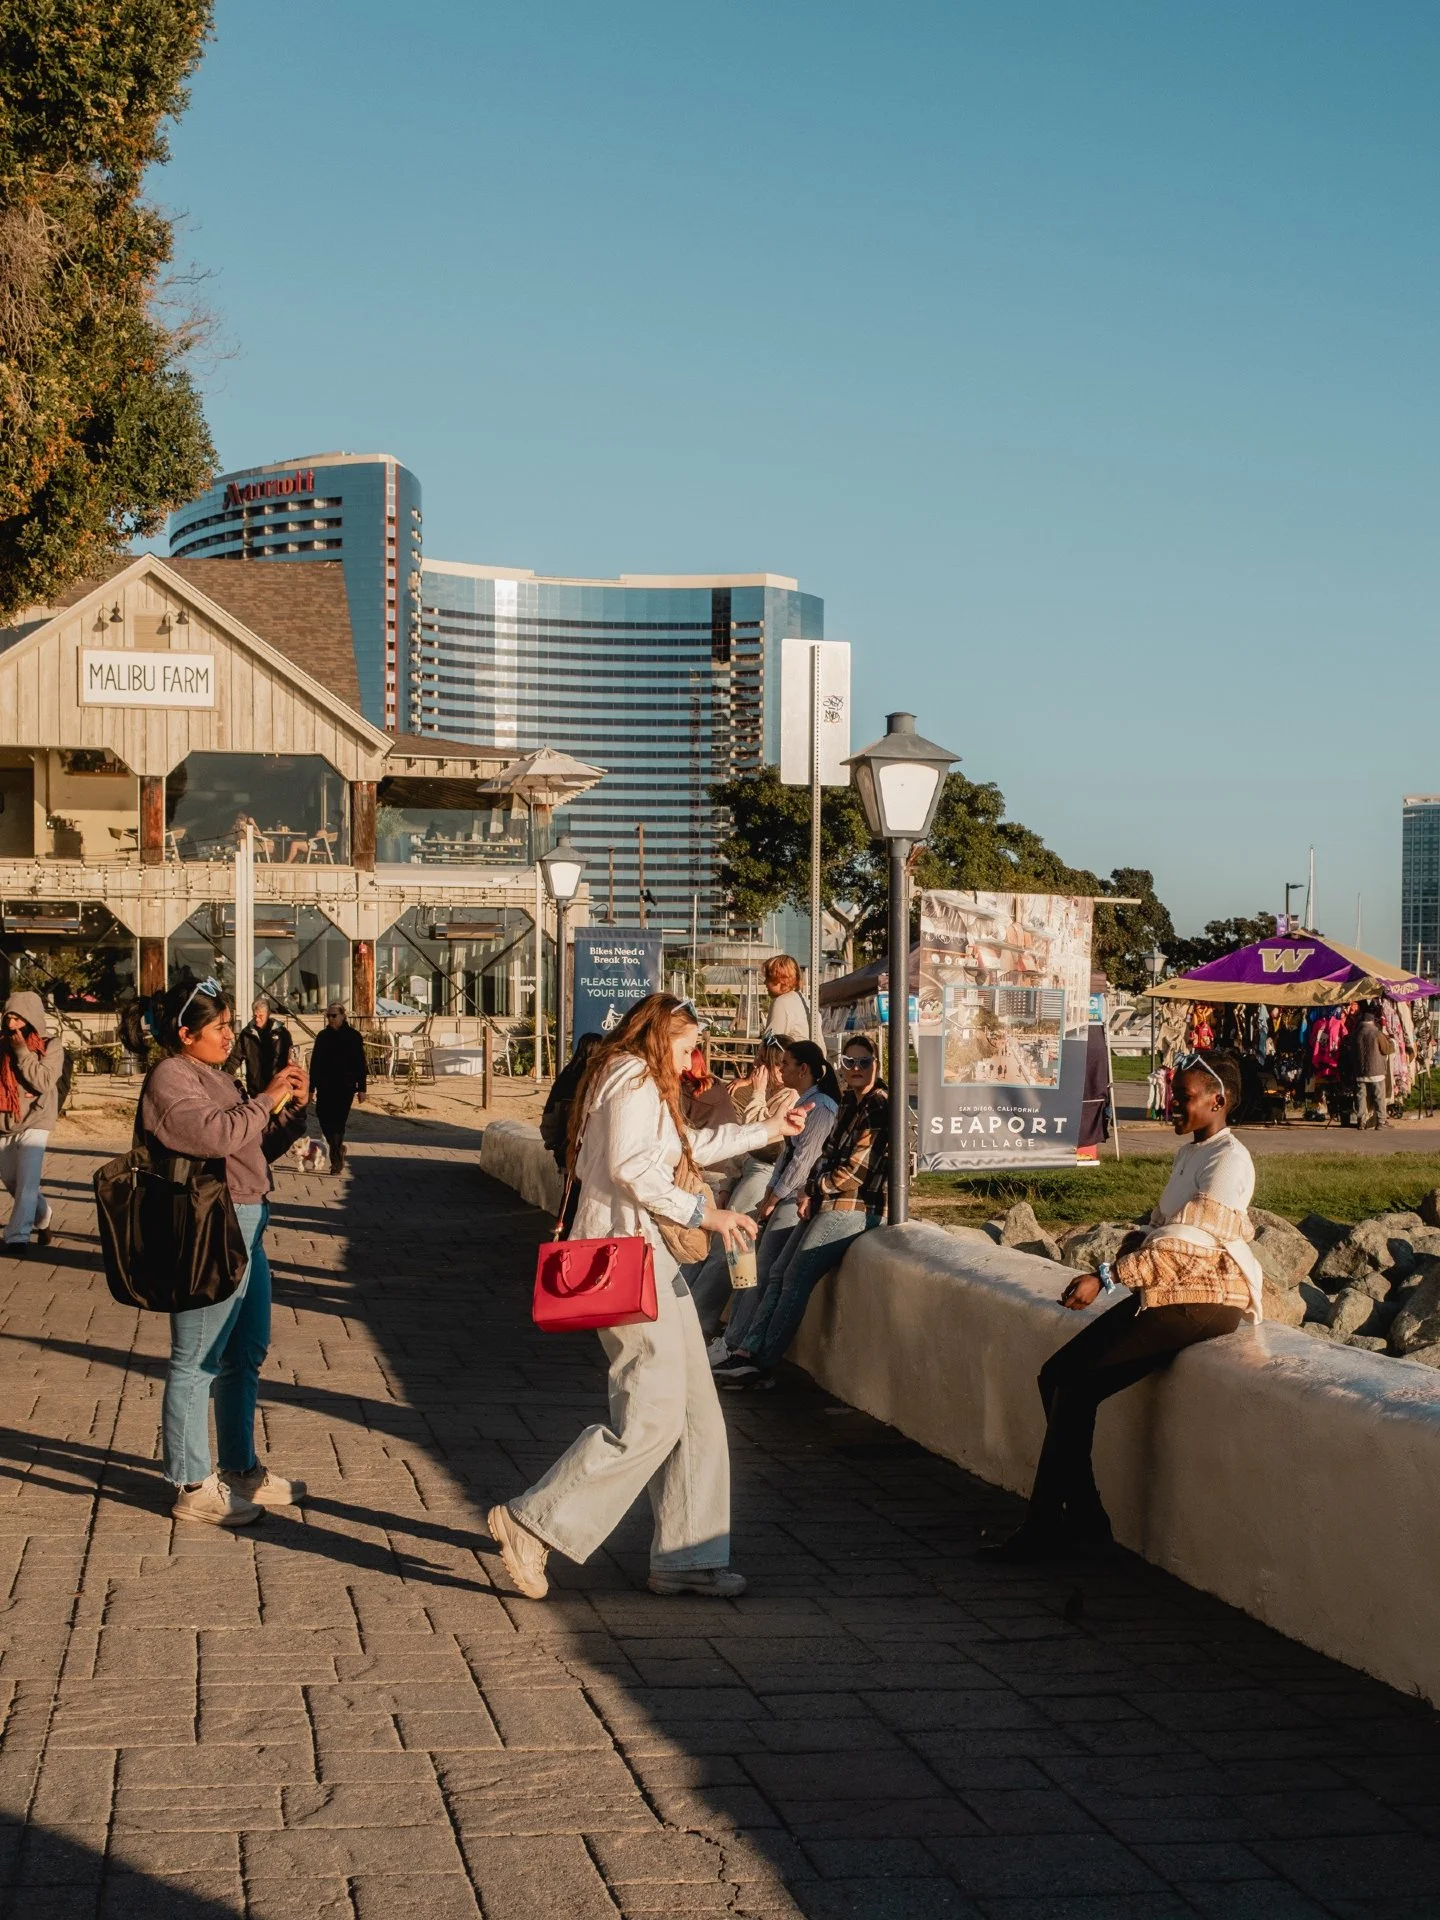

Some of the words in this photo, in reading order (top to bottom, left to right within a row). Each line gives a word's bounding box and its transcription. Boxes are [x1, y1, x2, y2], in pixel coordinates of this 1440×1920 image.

[222, 468, 315, 510] Marriott
[89, 663, 156, 692] MALIBU
[163, 665, 209, 694] FARM
[589, 947, 613, 956] Bikes
[614, 947, 637, 956] Need
[593, 955, 620, 964] Break
[621, 956, 641, 965] Too,
[1258, 948, 1315, 972] W
[580, 977, 619, 987] PLEASE
[620, 978, 651, 987] WALK
[587, 988, 615, 998] YOUR
[617, 989, 647, 998] BIKES
[930, 1116, 1068, 1134] SEAPORT
[960, 1138, 1035, 1148] VILLAGE
